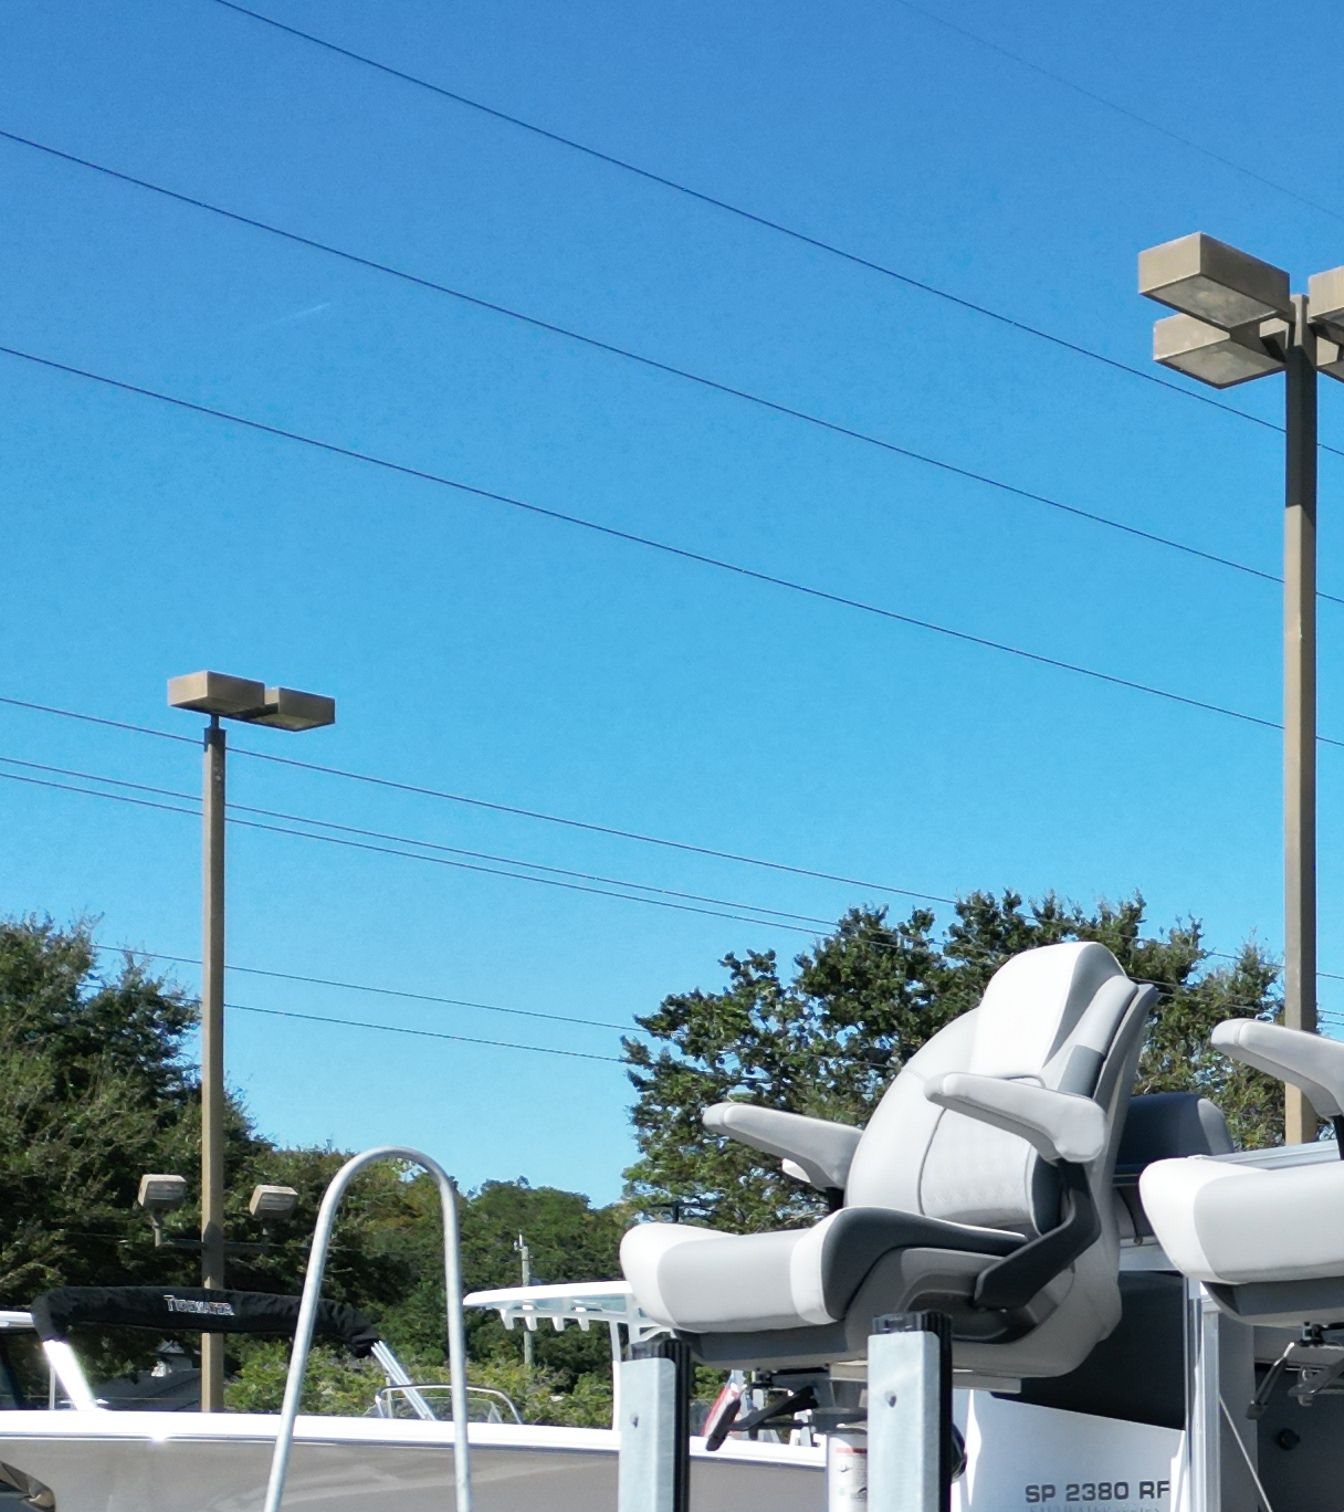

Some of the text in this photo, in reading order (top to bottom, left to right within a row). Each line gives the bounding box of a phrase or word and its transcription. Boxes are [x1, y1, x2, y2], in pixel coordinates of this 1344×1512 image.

[1025, 1480, 1170, 1503] SP 2380 RF
